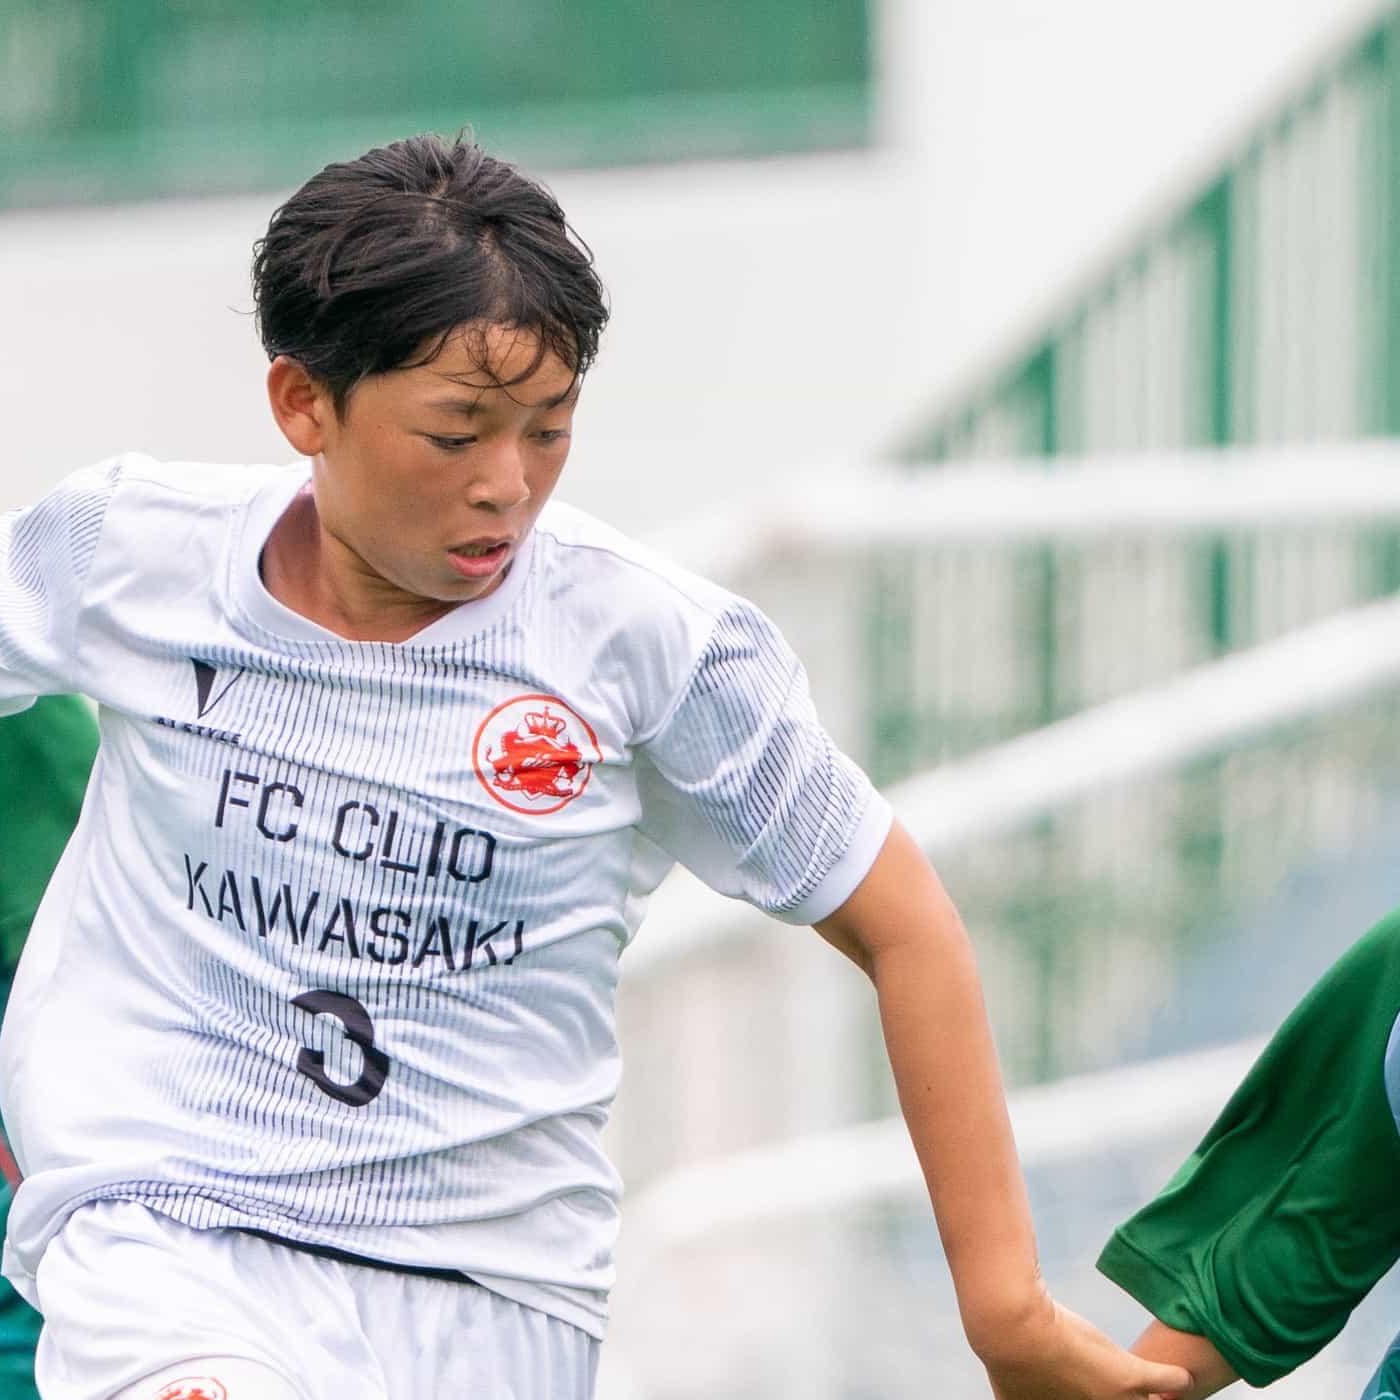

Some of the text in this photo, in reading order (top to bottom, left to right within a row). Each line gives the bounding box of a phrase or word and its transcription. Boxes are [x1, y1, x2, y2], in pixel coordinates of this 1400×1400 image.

[214, 768, 498, 884] FC CLIO
[183, 853, 526, 972] KAWASAKI
[290, 988, 390, 1108] 3
